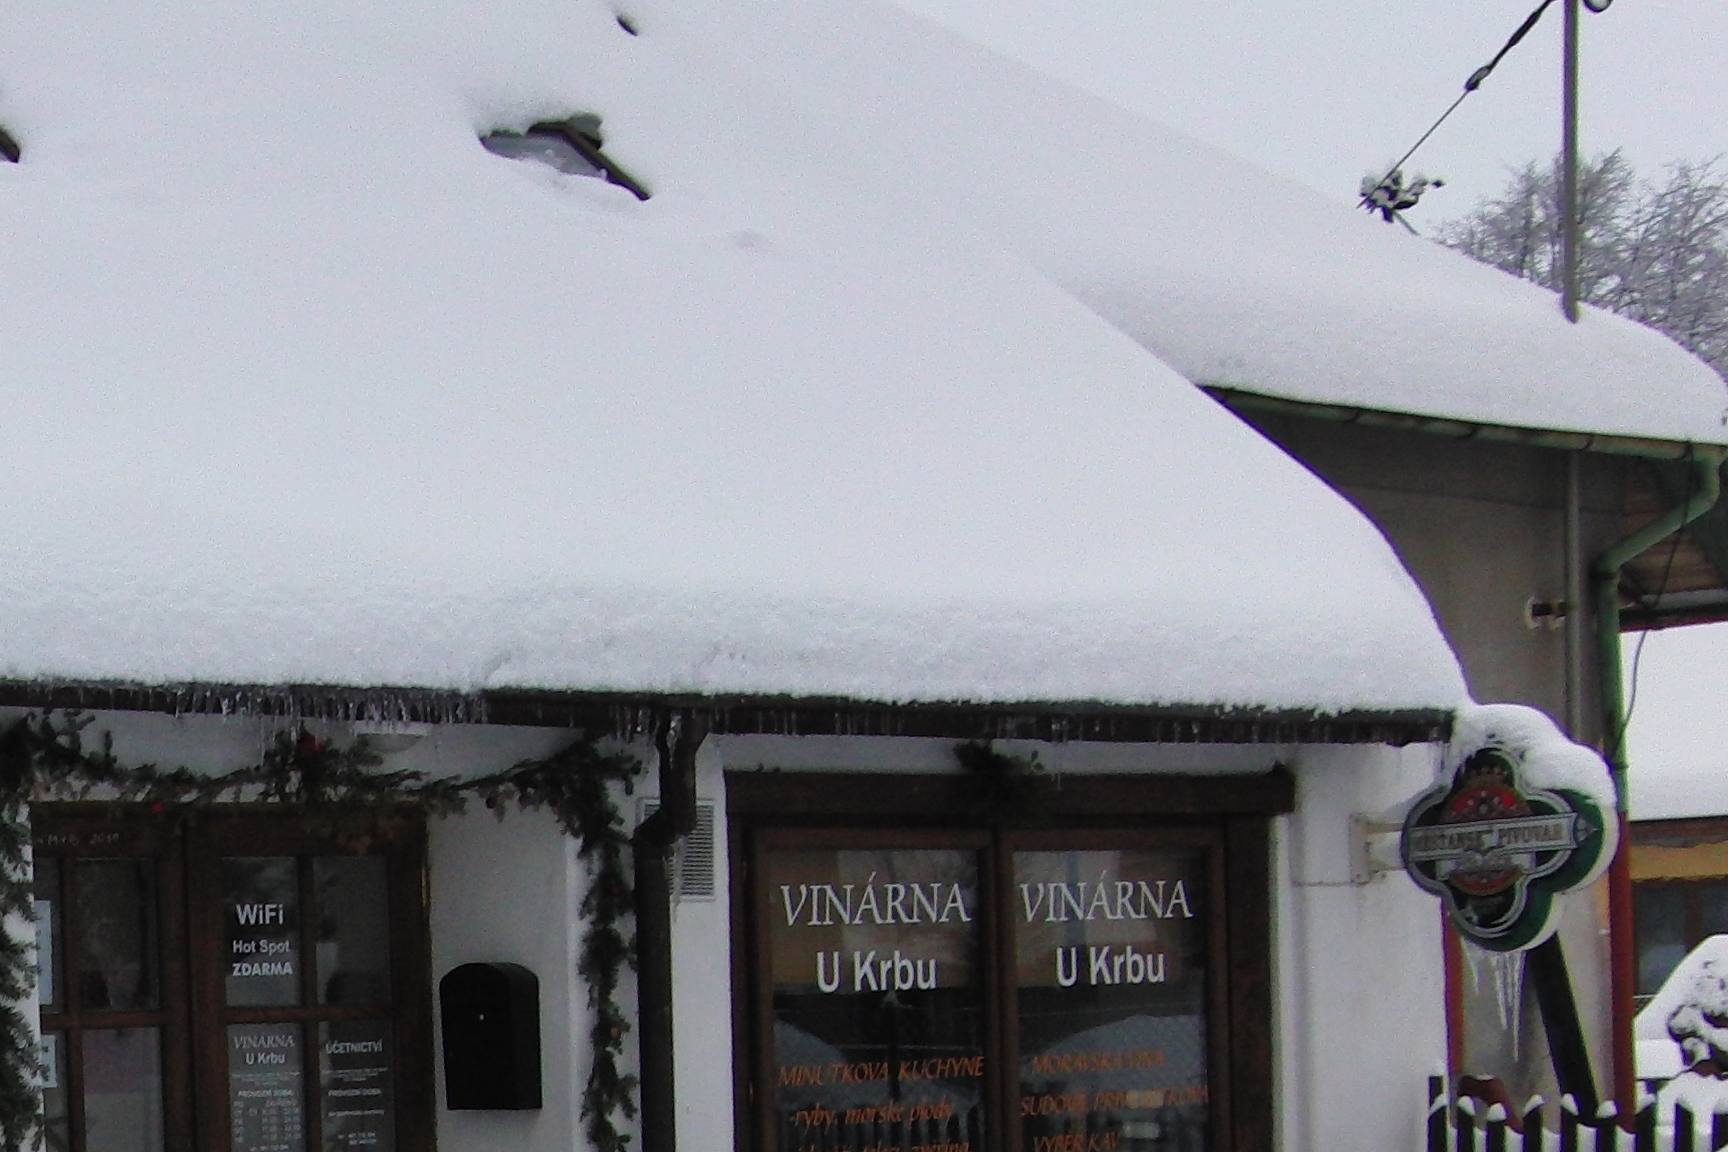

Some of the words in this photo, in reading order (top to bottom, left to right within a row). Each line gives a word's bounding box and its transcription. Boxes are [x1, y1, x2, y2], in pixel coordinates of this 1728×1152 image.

[780, 871, 972, 927] VINÁRNA
[1019, 870, 1193, 922] VINÁRNA
[235, 903, 284, 925] WiFi
[232, 939, 257, 954] Hot
[259, 939, 291, 957] Spot
[231, 961, 293, 977] ZDARMA
[816, 950, 840, 994] U
[853, 950, 937, 992] Krbu
[1056, 946, 1077, 988] U
[1090, 945, 1166, 985] Krbu
[325, 1038, 383, 1055] ÚČETNICTVÍ
[245, 1051, 255, 1066] U
[257, 1051, 286, 1065] Krbu
